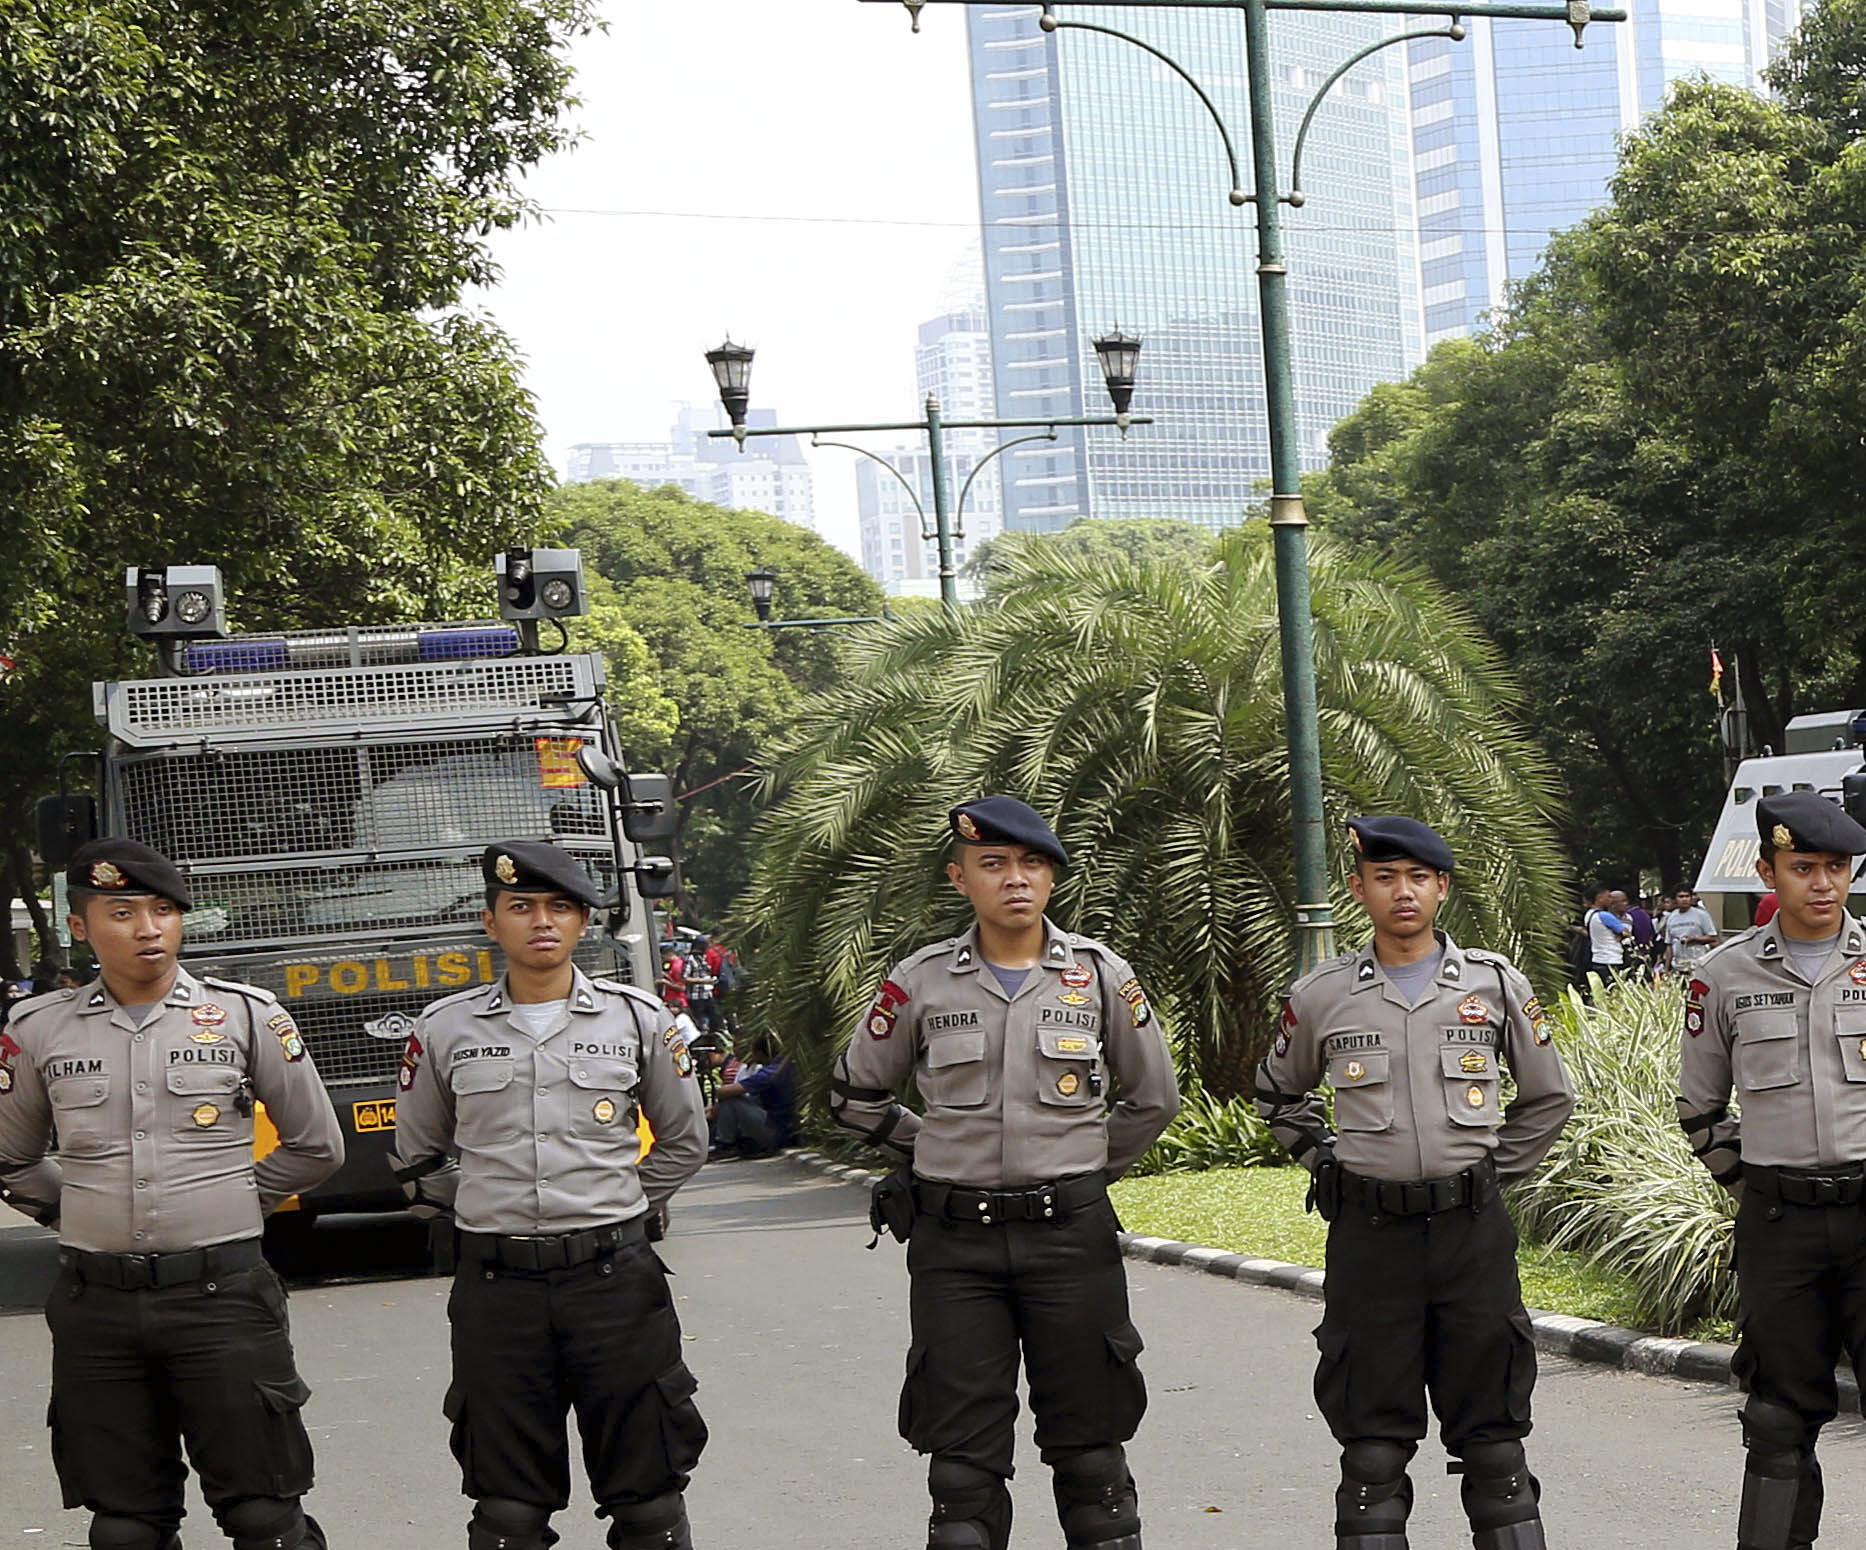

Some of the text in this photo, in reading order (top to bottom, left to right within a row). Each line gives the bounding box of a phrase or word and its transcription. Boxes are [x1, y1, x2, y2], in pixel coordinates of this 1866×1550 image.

[285, 950, 494, 998] POLISI
[927, 1012, 979, 1031] HENDRA
[1042, 1009, 1097, 1028] POLISI
[1328, 1033, 1382, 1050] SAPUTRA
[1446, 1029, 1496, 1043] POLISI
[169, 1049, 237, 1065] POLISI
[481, 1046, 511, 1058] YAZID
[574, 1042, 633, 1058] POLISI
